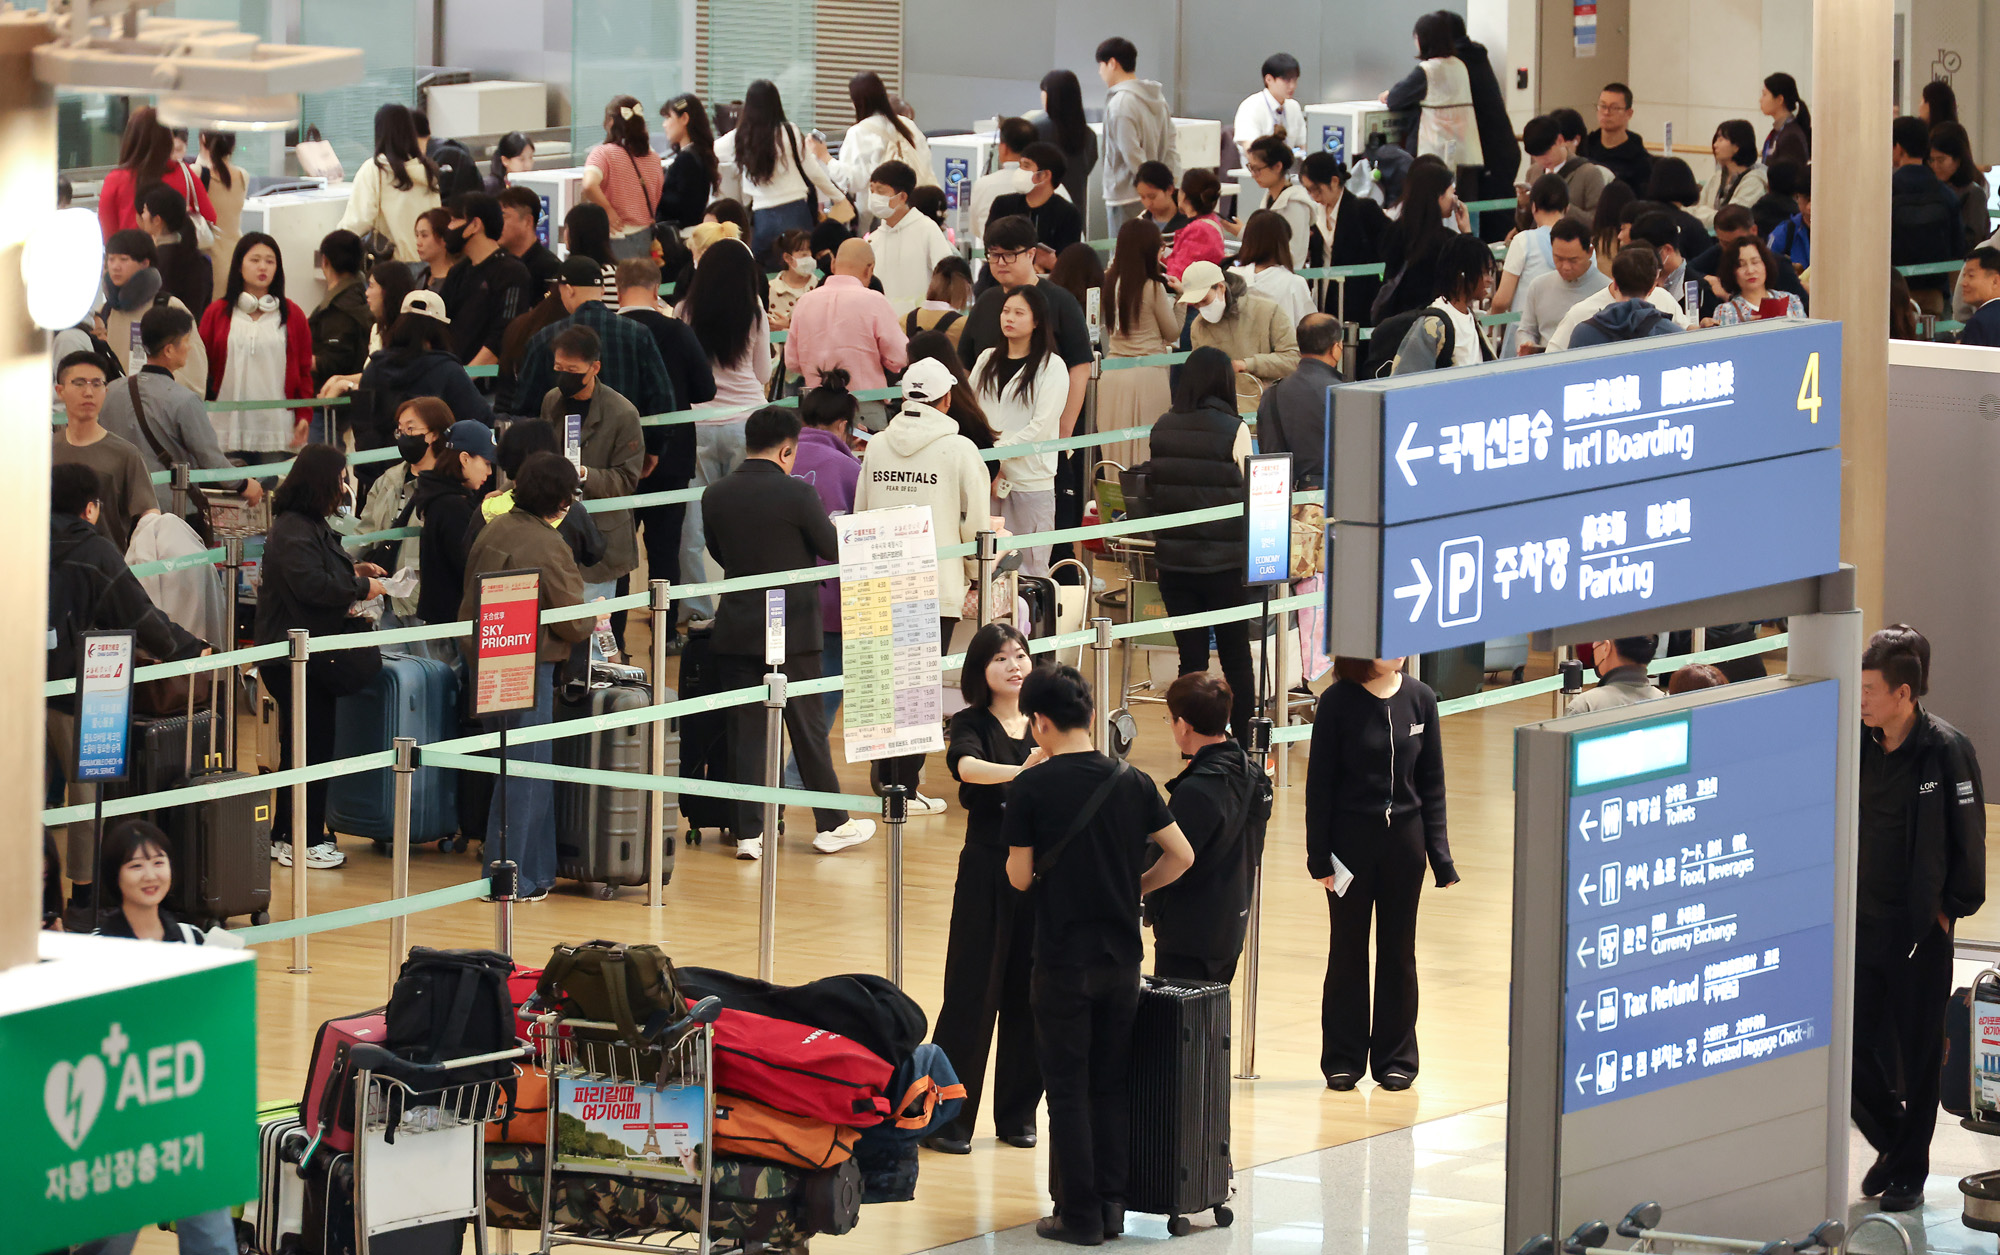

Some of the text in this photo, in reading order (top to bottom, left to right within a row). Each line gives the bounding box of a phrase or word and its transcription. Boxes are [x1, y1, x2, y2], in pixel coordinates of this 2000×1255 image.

[1796, 351, 1823, 424] 4
[1438, 408, 1554, 476] 국제선탑승
[1563, 419, 1696, 472] Int'l Boarding
[873, 470, 938, 485] ESSENTIALS
[1255, 554, 1281, 564] ECONOMY
[1259, 565, 1276, 575] CLASS
[1493, 536, 1571, 600] 주차장
[1579, 555, 1655, 601] Parking
[1448, 551, 1476, 615] P
[924, 602, 936, 610] 12:00
[481, 633, 532, 649] PRIORITY
[482, 624, 504, 637] SKY
[1665, 805, 1696, 826] Toilets
[1680, 857, 1755, 888] Food, Beverages
[1651, 922, 1738, 956] Currency Exchange
[1622, 973, 1700, 1019] Tax Refund
[1621, 1054, 1633, 1082] 큰
[1651, 1043, 1683, 1073] 부치는
[1686, 1037, 1698, 1065] 곳
[1702, 1022, 1815, 1068] Oversized Baggage Check-in
[115, 1039, 206, 1112] AED
[573, 1086, 636, 1103] 파리갈때
[582, 1102, 642, 1121] 여기어때
[45, 1131, 205, 1204] 자동심장충격기
